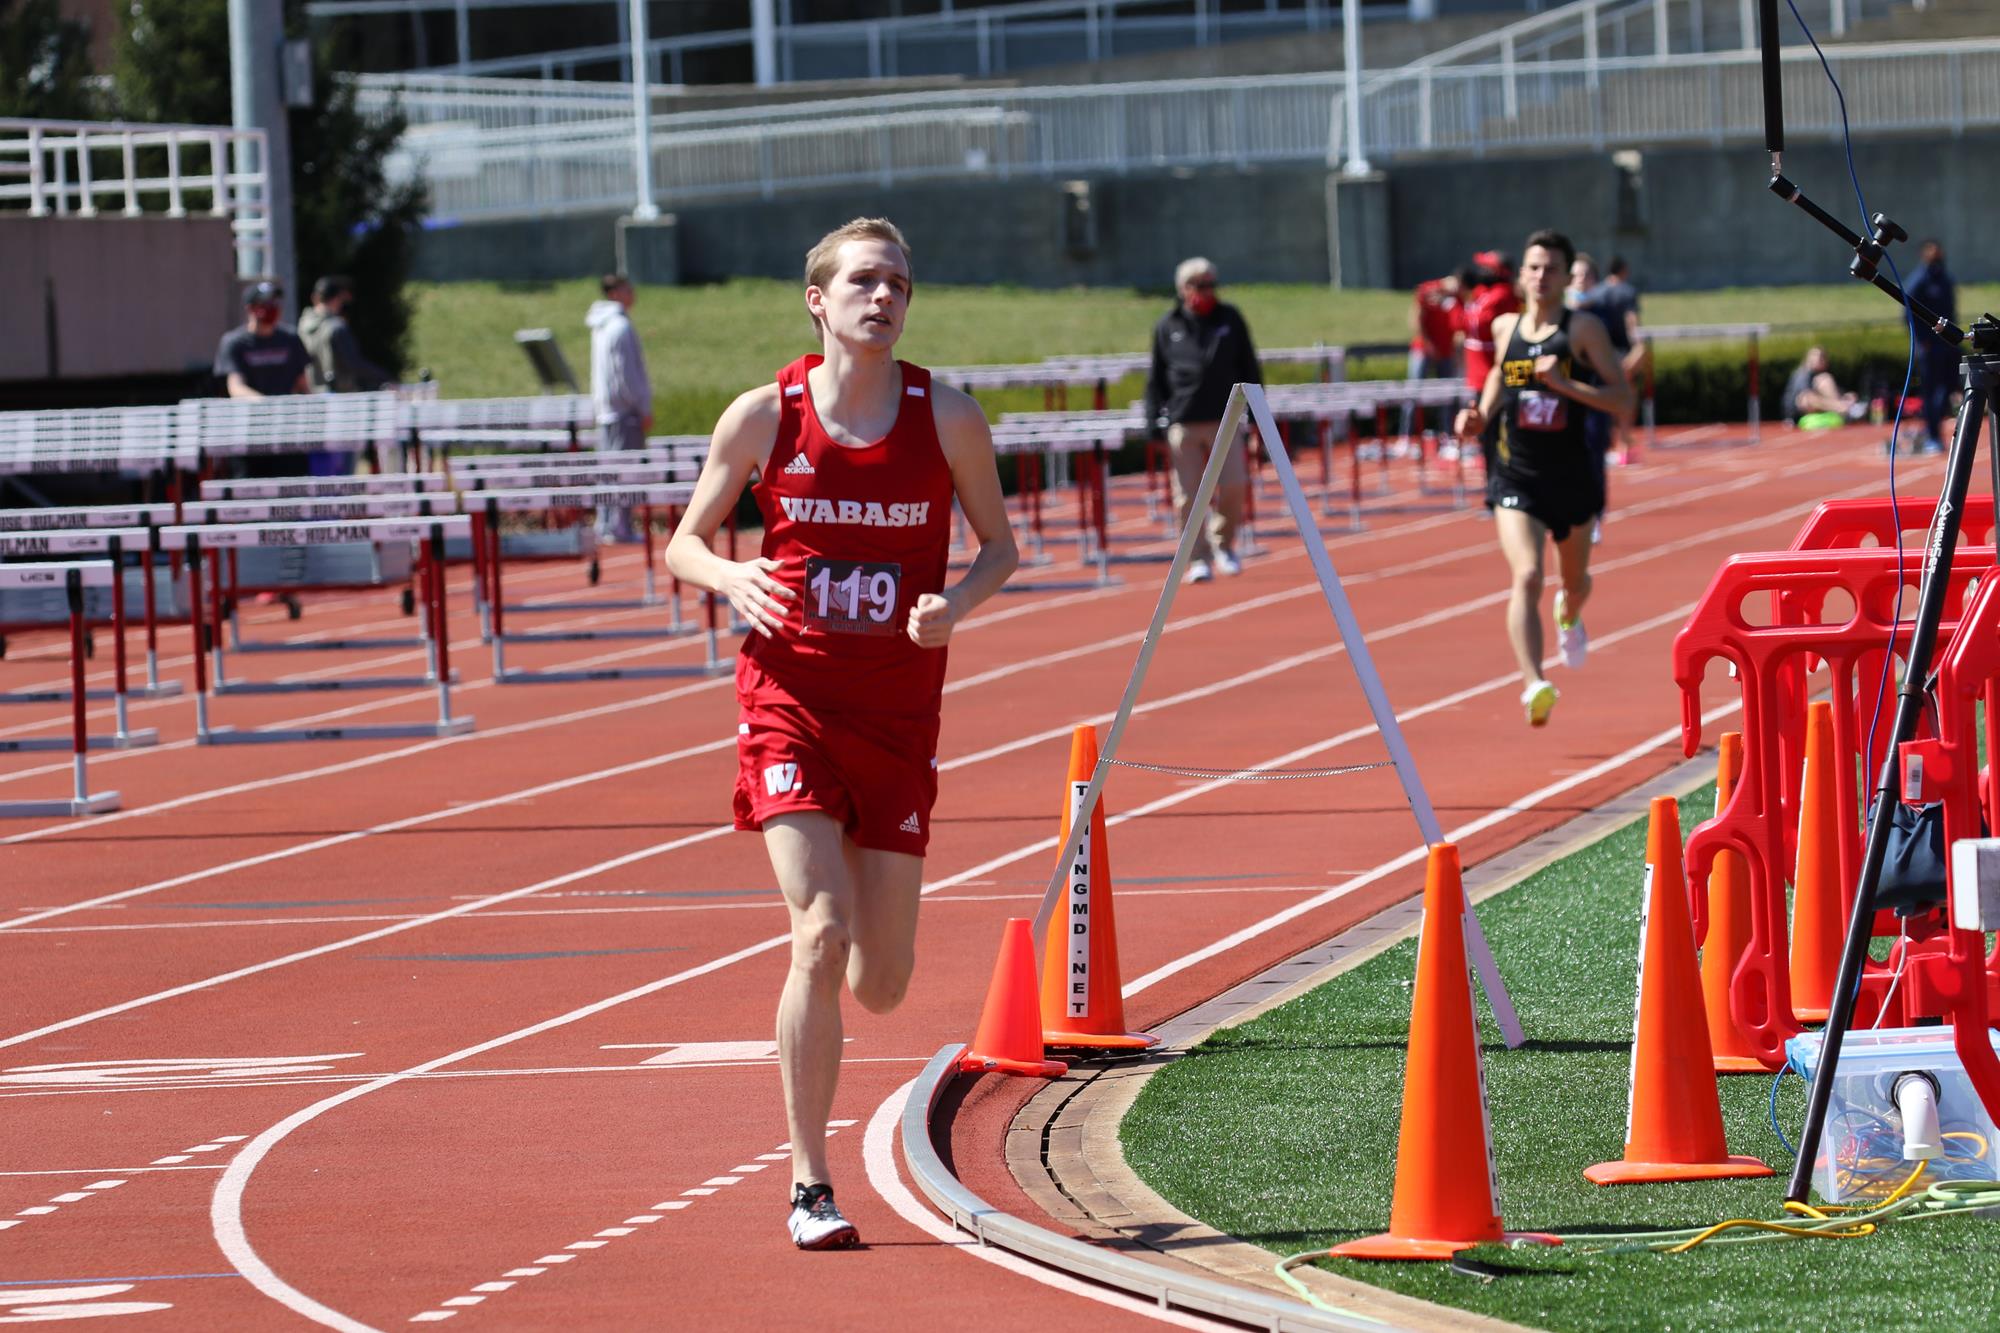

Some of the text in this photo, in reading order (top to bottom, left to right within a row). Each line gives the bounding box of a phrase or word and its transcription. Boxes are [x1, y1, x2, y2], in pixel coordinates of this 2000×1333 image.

[784, 466, 815, 474] adidas
[780, 496, 929, 527] WABASH
[810, 567, 896, 622] 119
